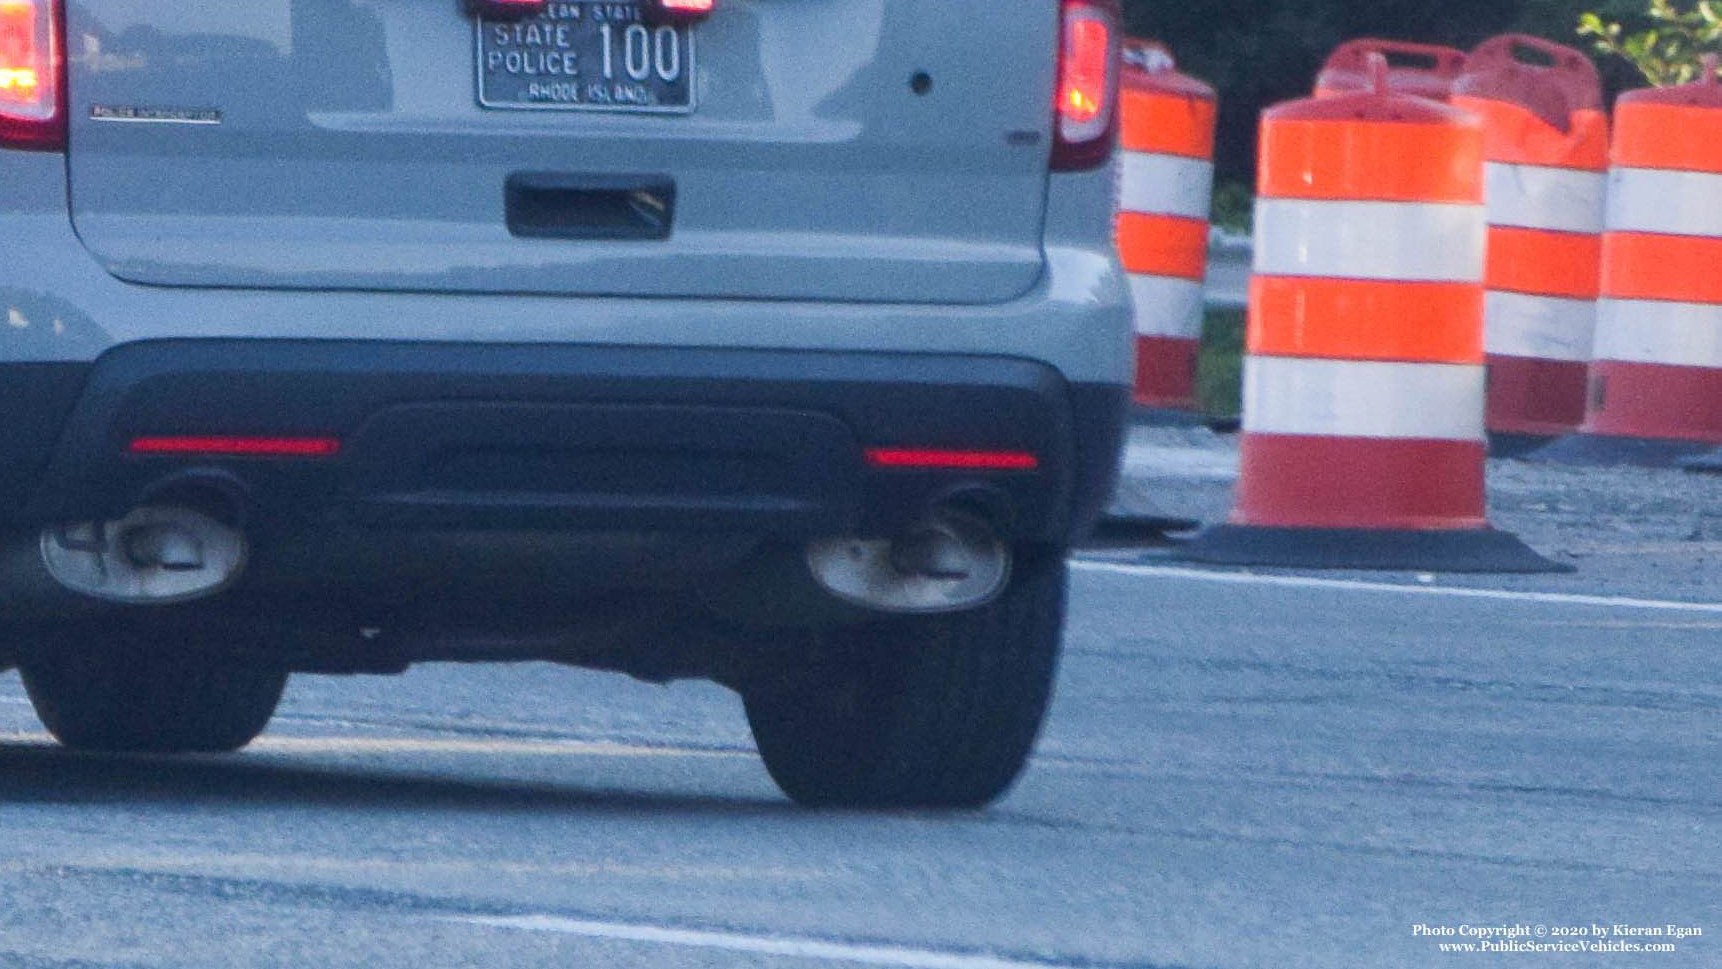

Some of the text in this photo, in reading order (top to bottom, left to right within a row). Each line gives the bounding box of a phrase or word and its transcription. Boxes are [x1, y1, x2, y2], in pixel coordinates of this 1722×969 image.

[493, 22, 571, 48] STATE
[487, 50, 578, 75] POLICE
[600, 23, 680, 82] 100
[528, 82, 578, 103] RHODE
